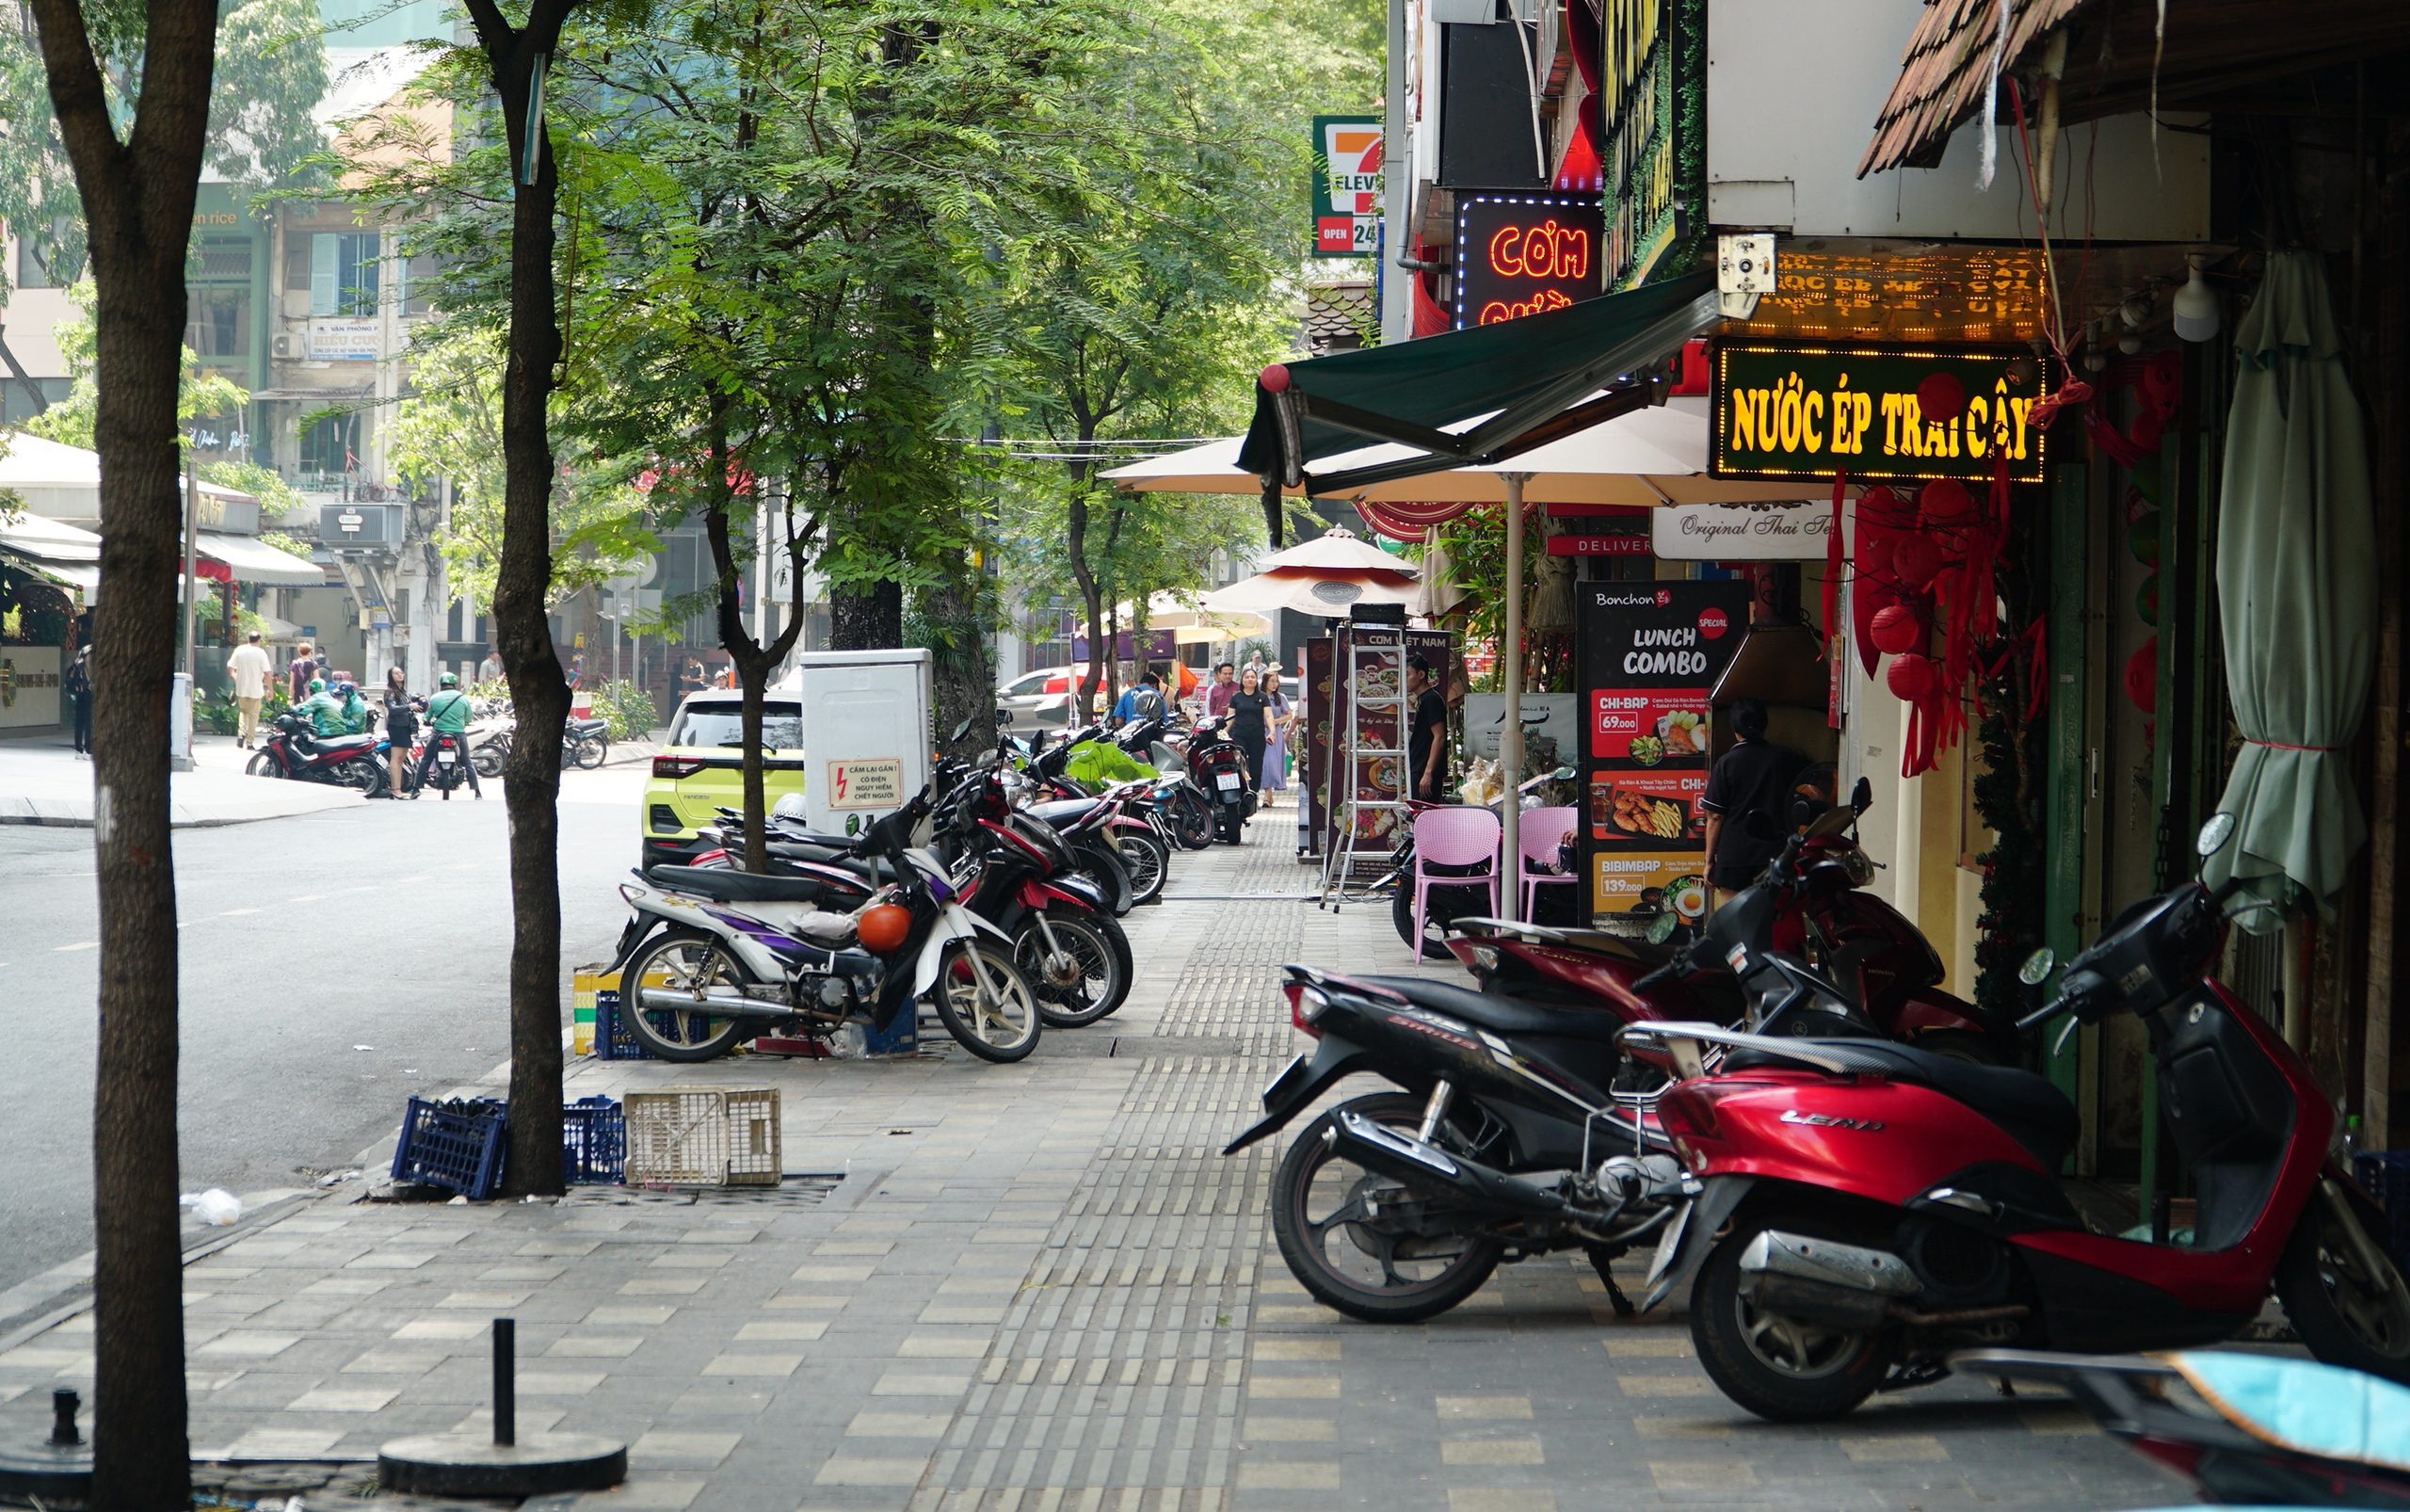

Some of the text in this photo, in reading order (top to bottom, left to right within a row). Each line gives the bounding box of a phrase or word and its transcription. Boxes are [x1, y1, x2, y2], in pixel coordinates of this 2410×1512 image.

[1335, 175, 1375, 191] ELEV
[191, 211, 237, 224] en rice
[1324, 229, 1347, 240] OPEN
[1490, 219, 1588, 279] CƠM
[1731, 371, 1824, 454] NƯỚC
[1830, 373, 1872, 455] ÉP
[1966, 377, 2032, 460] CÂY
[1679, 513, 1834, 543] Original Thai Te
[1578, 539, 1650, 552] DELIVER
[1596, 593, 1655, 606] Bonchon
[1698, 618, 1728, 628] SPECIAL
[1369, 635, 1446, 648] CƠM ỆT NAM
[1633, 627, 1696, 647] LUNCH
[1623, 651, 1708, 675] COMBO
[1599, 697, 1649, 709] CHI-BAP
[1602, 716, 1636, 729] 69.000
[866, 766, 877, 775] LẠI
[1680, 778, 1709, 790] CHI-
[1601, 860, 1662, 873] BIBIMBAP
[1604, 879, 1643, 892] 139.000
[1867, 968, 1896, 976] HONDA
[1384, 1014, 1481, 1052] SIRIUS
